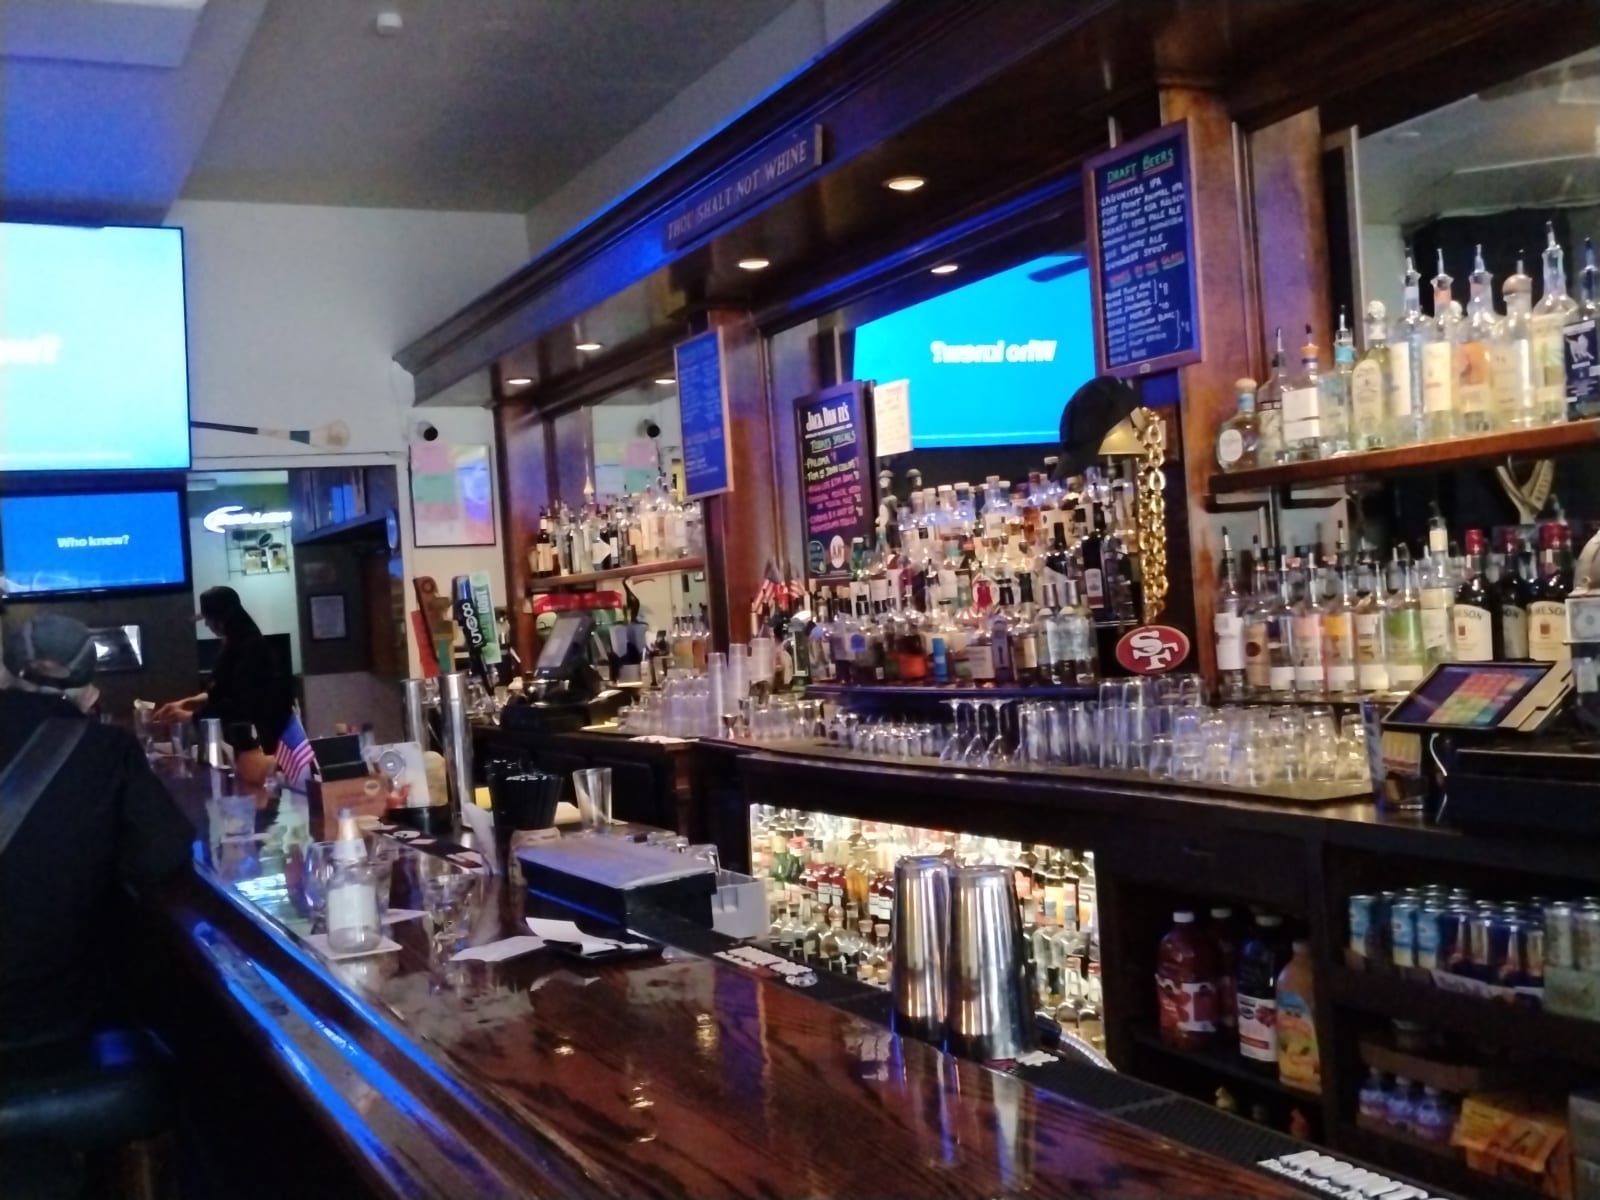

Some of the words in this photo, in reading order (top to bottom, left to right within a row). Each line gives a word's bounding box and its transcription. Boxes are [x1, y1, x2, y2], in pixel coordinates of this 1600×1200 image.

[696, 186, 733, 221] SHALT
[736, 168, 762, 198] NOT
[765, 140, 809, 181] WHINE
[1107, 163, 1137, 184] DRAFT
[1142, 148, 1174, 170] BEERS
[1144, 242, 1168, 257] STOUT
[56, 537, 87, 548] Who
[88, 534, 130, 546] knew?
[462, 602, 482, 644] 805
[1130, 630, 1179, 670] SF
